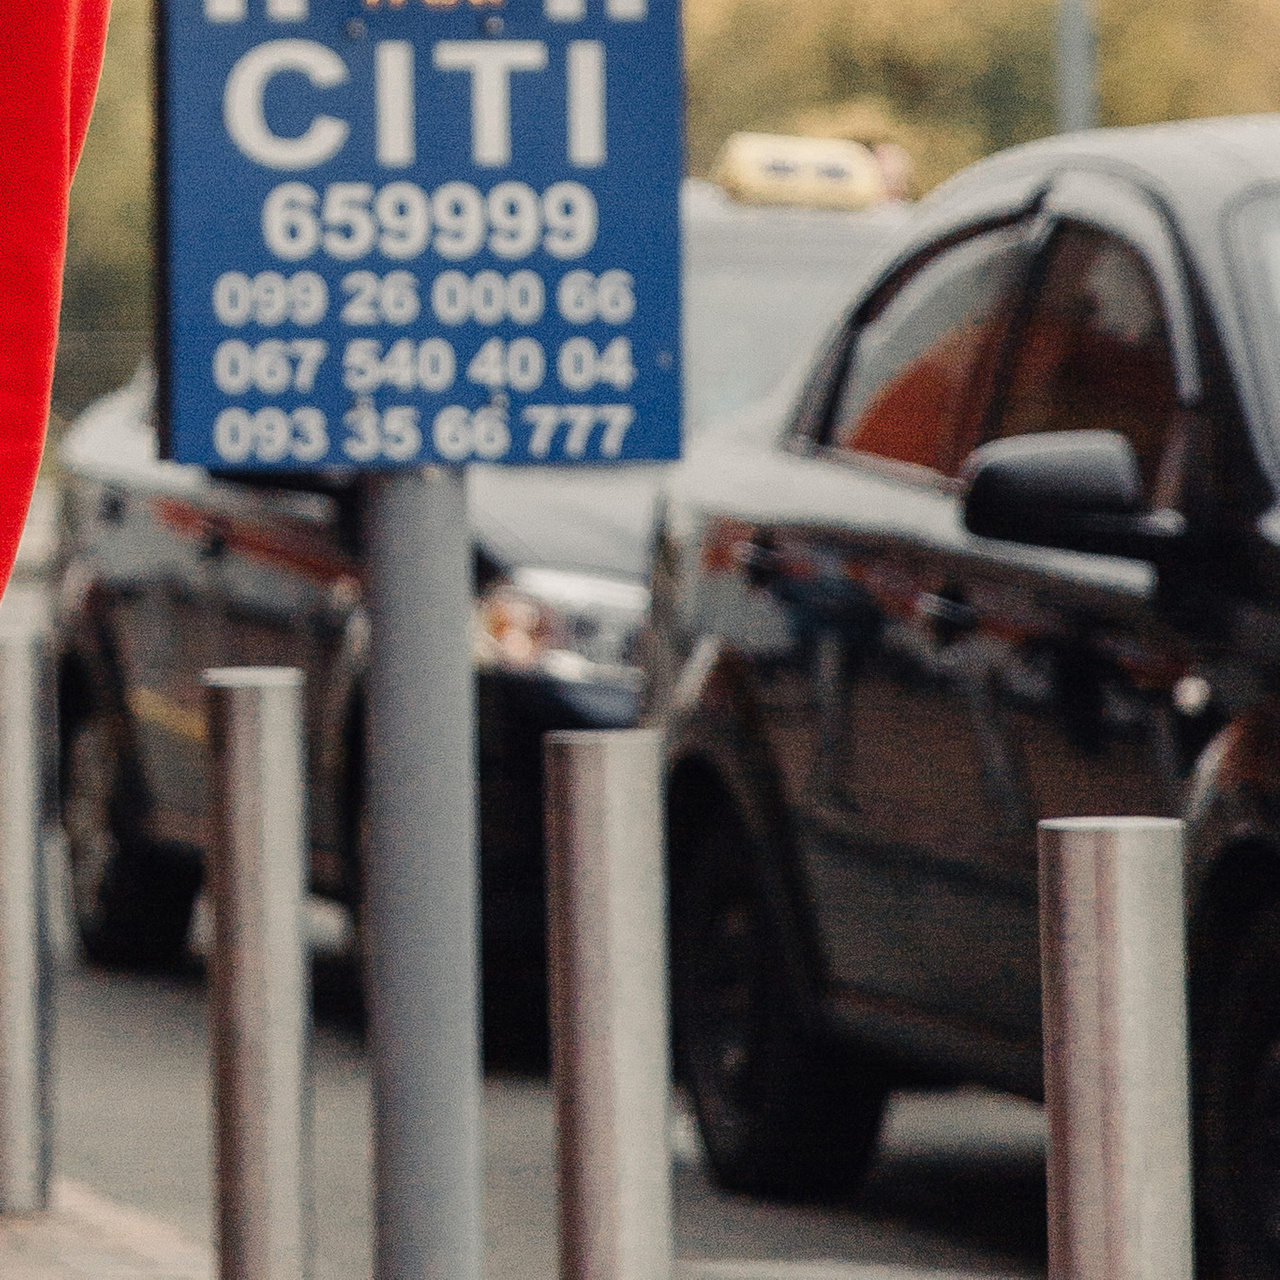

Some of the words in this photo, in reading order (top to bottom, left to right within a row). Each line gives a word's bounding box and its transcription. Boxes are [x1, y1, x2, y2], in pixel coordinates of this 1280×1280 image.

[223, 37, 608, 171] CITI
[261, 181, 599, 260] 659999
[213, 270, 328, 326] 099
[340, 270, 418, 326] 26
[431, 270, 546, 326] 000
[557, 269, 636, 326] 66
[214, 339, 326, 395] 067
[342, 338, 456, 393] 540
[467, 338, 546, 393] 40
[557, 338, 636, 393] 04
[214, 407, 328, 462] 093
[342, 406, 419, 461] 35
[432, 407, 511, 460] 66
[523, 404, 634, 458] 777
